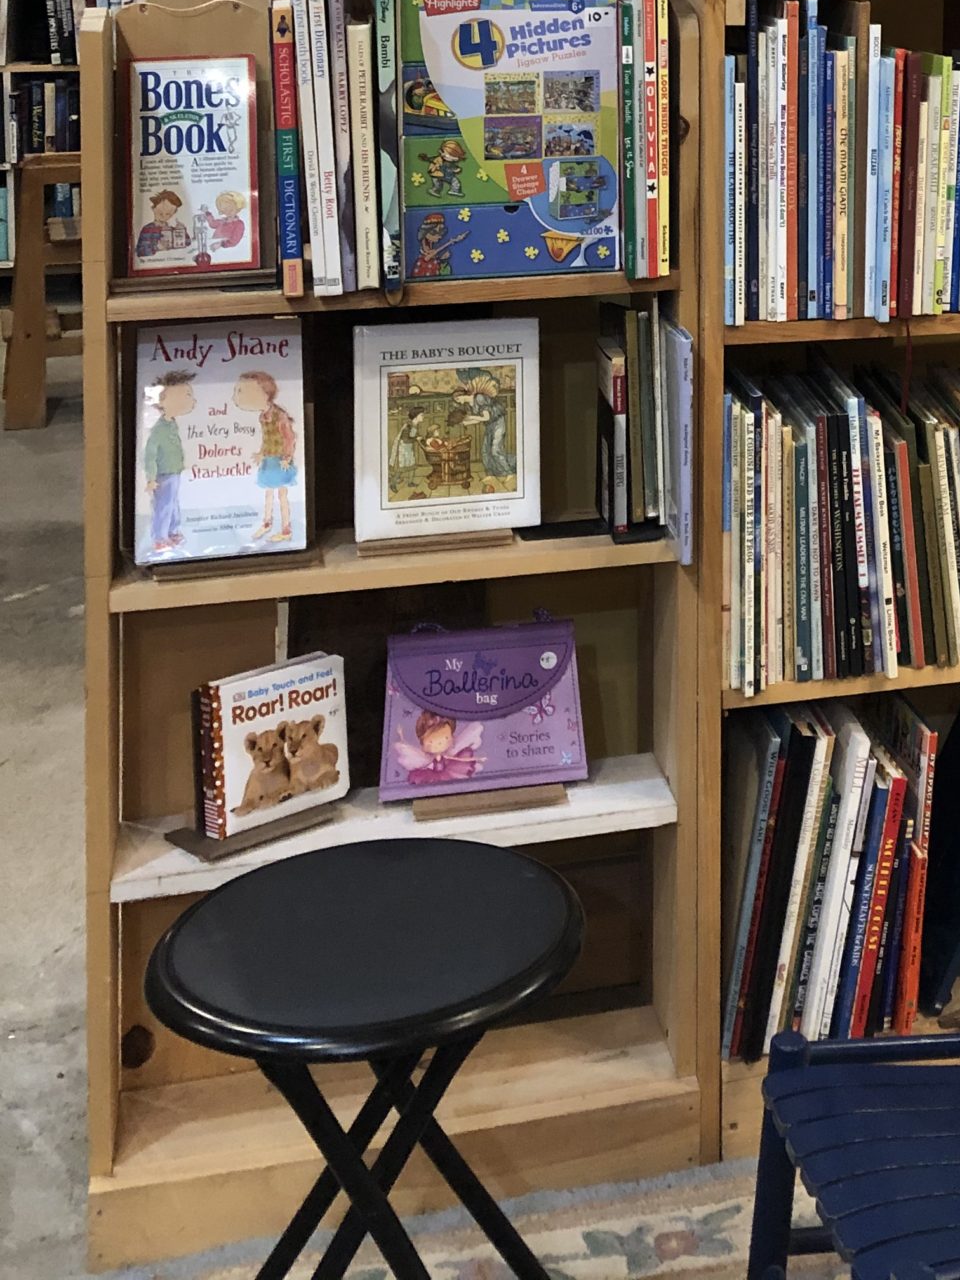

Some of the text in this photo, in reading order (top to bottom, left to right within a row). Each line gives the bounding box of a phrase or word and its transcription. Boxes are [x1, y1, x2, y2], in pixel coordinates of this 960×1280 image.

[314, 6, 323, 27] First
[508, 16, 585, 42] Hidden
[314, 30, 326, 79] Dictionary
[380, 35, 390, 69] Bambi
[459, 19, 499, 66] 4
[505, 33, 591, 59] Pictures
[516, 49, 587, 68] Jigsaw Puzzles
[139, 71, 241, 112] Bones
[952, 84, 960, 98] THE
[140, 114, 227, 156] Book
[645, 86, 656, 174] OLIVIA
[277, 47, 297, 256] SCHOLASTIC FIRST DICTIONARY
[948, 149, 956, 173] GOOSE
[323, 170, 333, 194] Betty
[325, 198, 334, 219] Root
[150, 330, 290, 368] Andy Shane
[380, 343, 523, 361] THE BABY'S BOUQUET
[208, 404, 228, 417] and
[187, 422, 256, 439] the Very Bossy
[746, 423, 754, 434] LA
[874, 429, 880, 440] My
[197, 443, 243, 460] Dolores
[746, 437, 754, 471] CORONA
[444, 658, 464, 673] My
[247, 667, 333, 700] Baby Touch and Feel
[422, 669, 538, 698] Ballerina
[231, 678, 337, 725] Roar! Roar!
[475, 691, 498, 706] bag
[508, 730, 552, 745] Stories
[506, 744, 555, 759] to share
